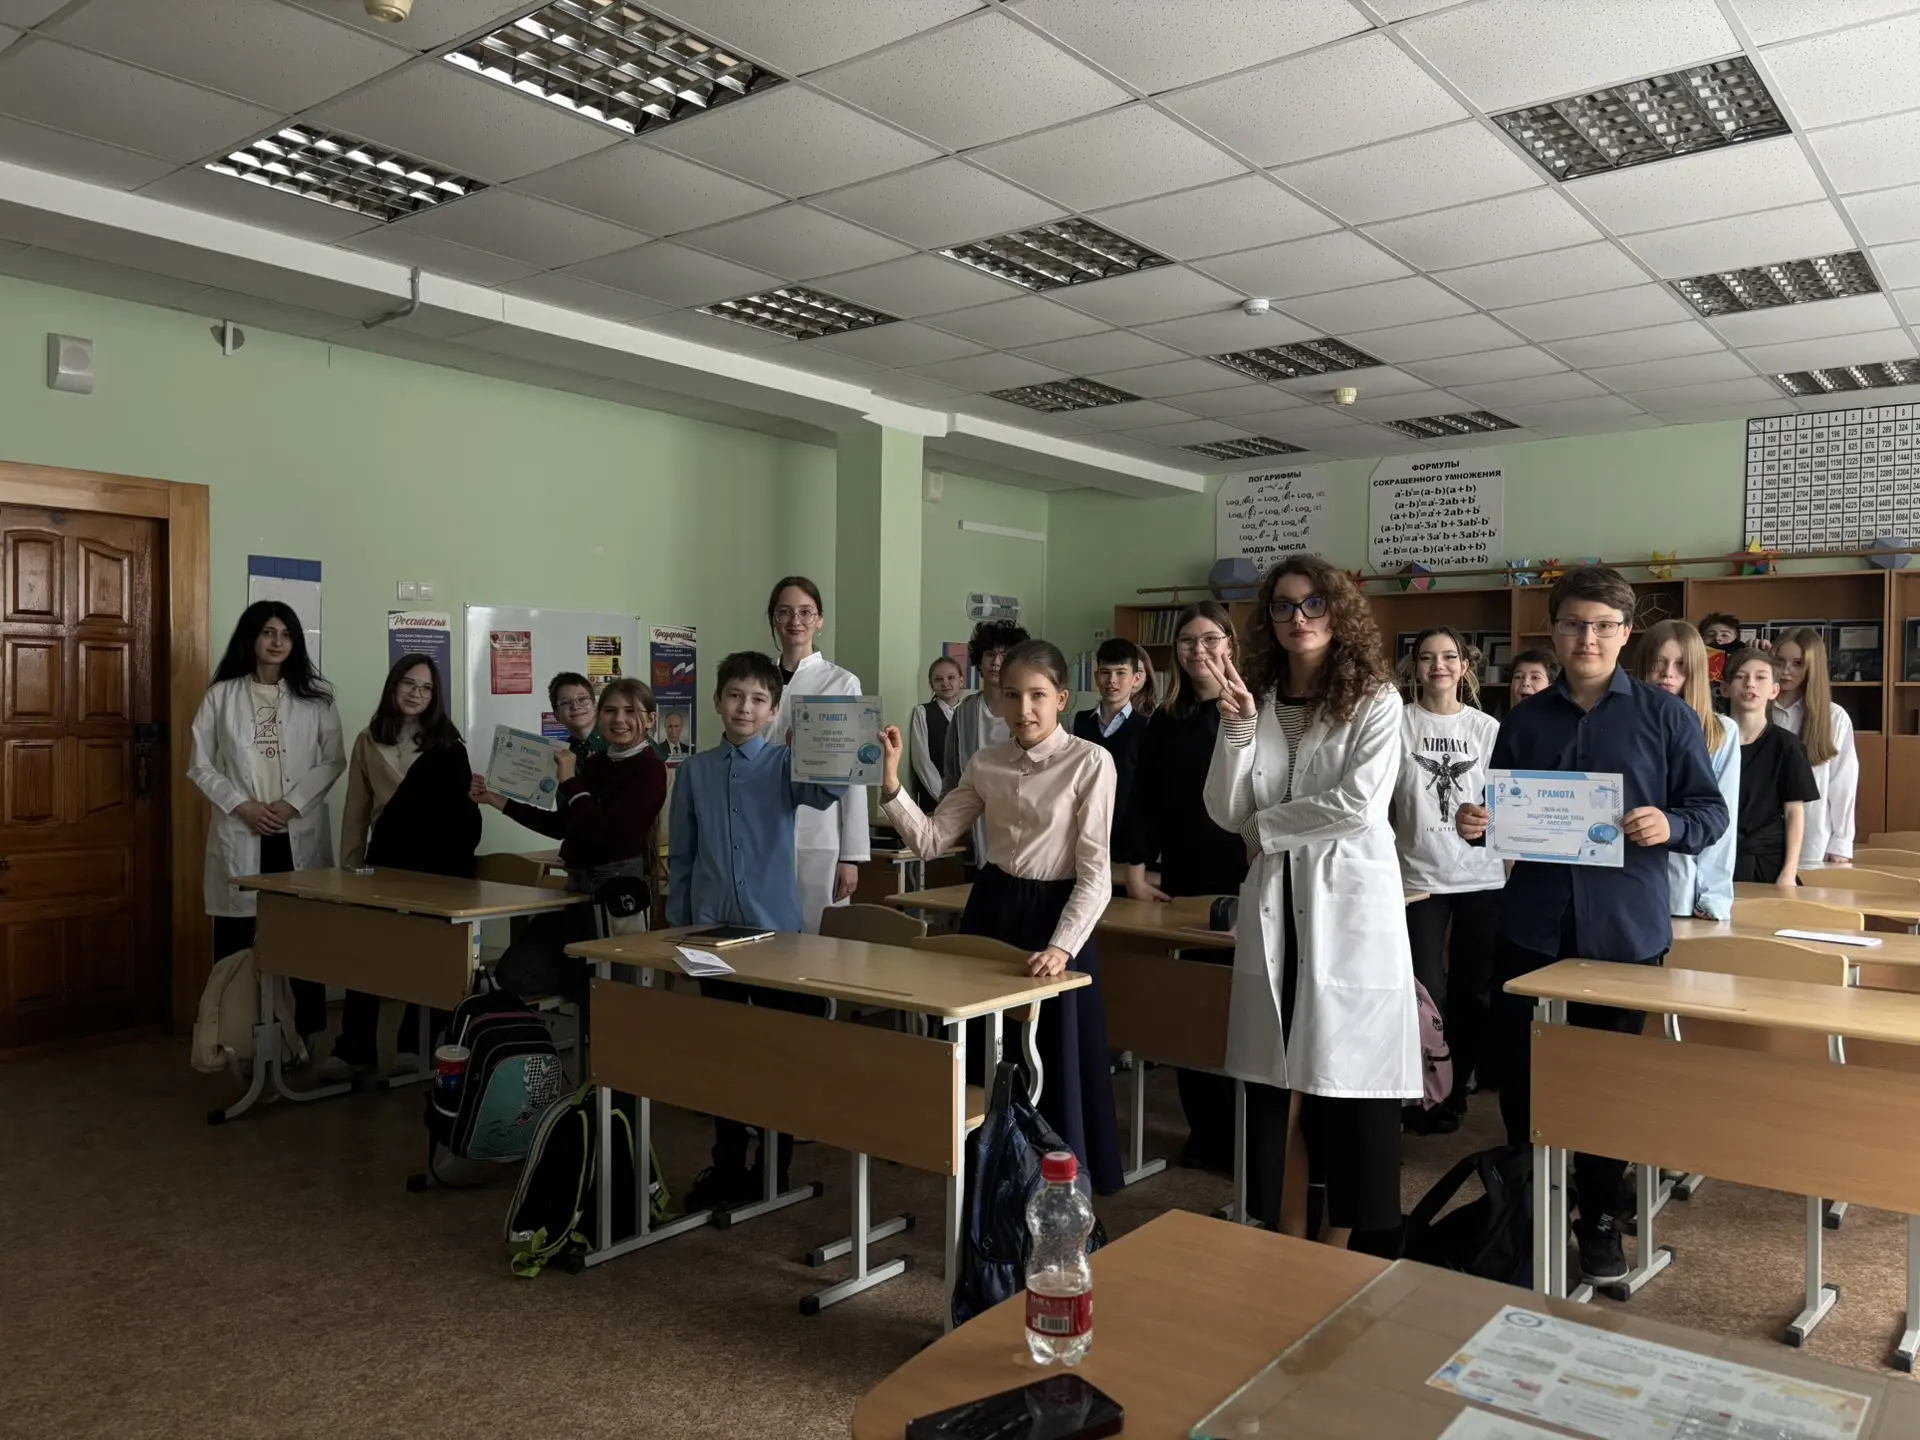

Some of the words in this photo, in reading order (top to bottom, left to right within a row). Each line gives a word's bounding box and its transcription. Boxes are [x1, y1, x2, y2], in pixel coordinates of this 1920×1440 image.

[1886, 410, 1890, 418] 7
[1411, 461, 1460, 471] ФОРМУЛЫ
[1248, 471, 1302, 483] ЛОГАРИФМЫ
[1373, 475, 1443, 487] СОКРАЩЕННОГО
[1445, 470, 1501, 481] УМНОЖЕНИЯ
[1242, 545, 1276, 554] МОДУЛЬ
[1278, 542, 1307, 551] ЧИСЛА
[393, 614, 447, 627] Российская
[1422, 737, 1468, 754] NIRVANA
[1537, 789, 1575, 799] ГРАМОТА
